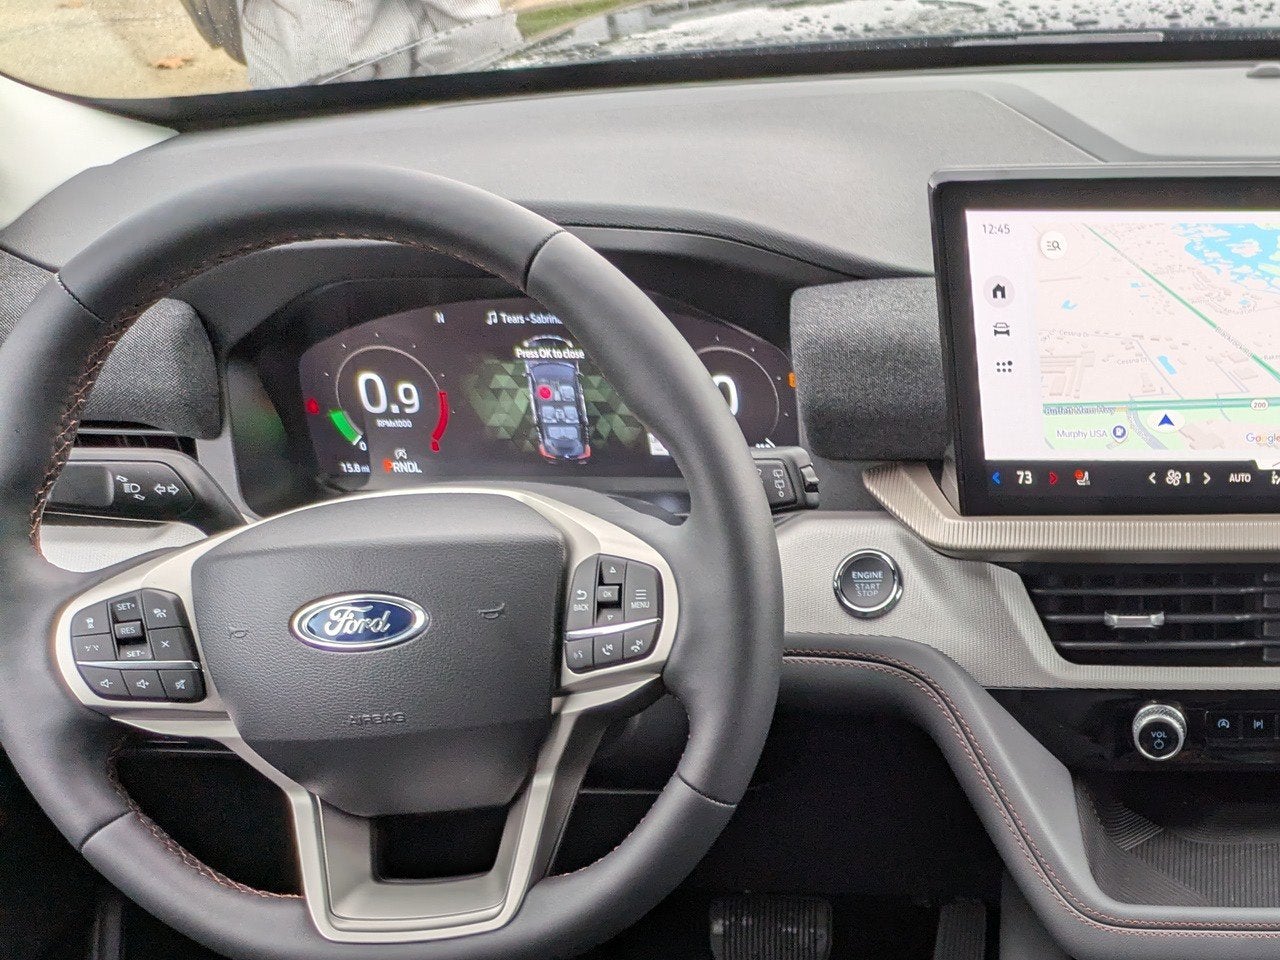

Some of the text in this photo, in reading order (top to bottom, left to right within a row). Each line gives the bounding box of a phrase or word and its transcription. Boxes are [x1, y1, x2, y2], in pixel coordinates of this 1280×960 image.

[982, 223, 1011, 235] 12:45
[500, 312, 525, 324] Tears
[515, 347, 585, 359] Press OK to close
[358, 373, 420, 413] 0.9
[1253, 401, 1266, 409] 200
[1056, 430, 1108, 439] Murphy USA
[1016, 470, 1033, 485] 73
[1229, 472, 1252, 483] AUTO
[851, 571, 884, 579] ENGINE
[855, 583, 881, 591] START
[573, 604, 589, 612] BACK
[630, 601, 650, 609] MENU
[324, 605, 391, 637] Ford
[121, 626, 136, 635] RES
